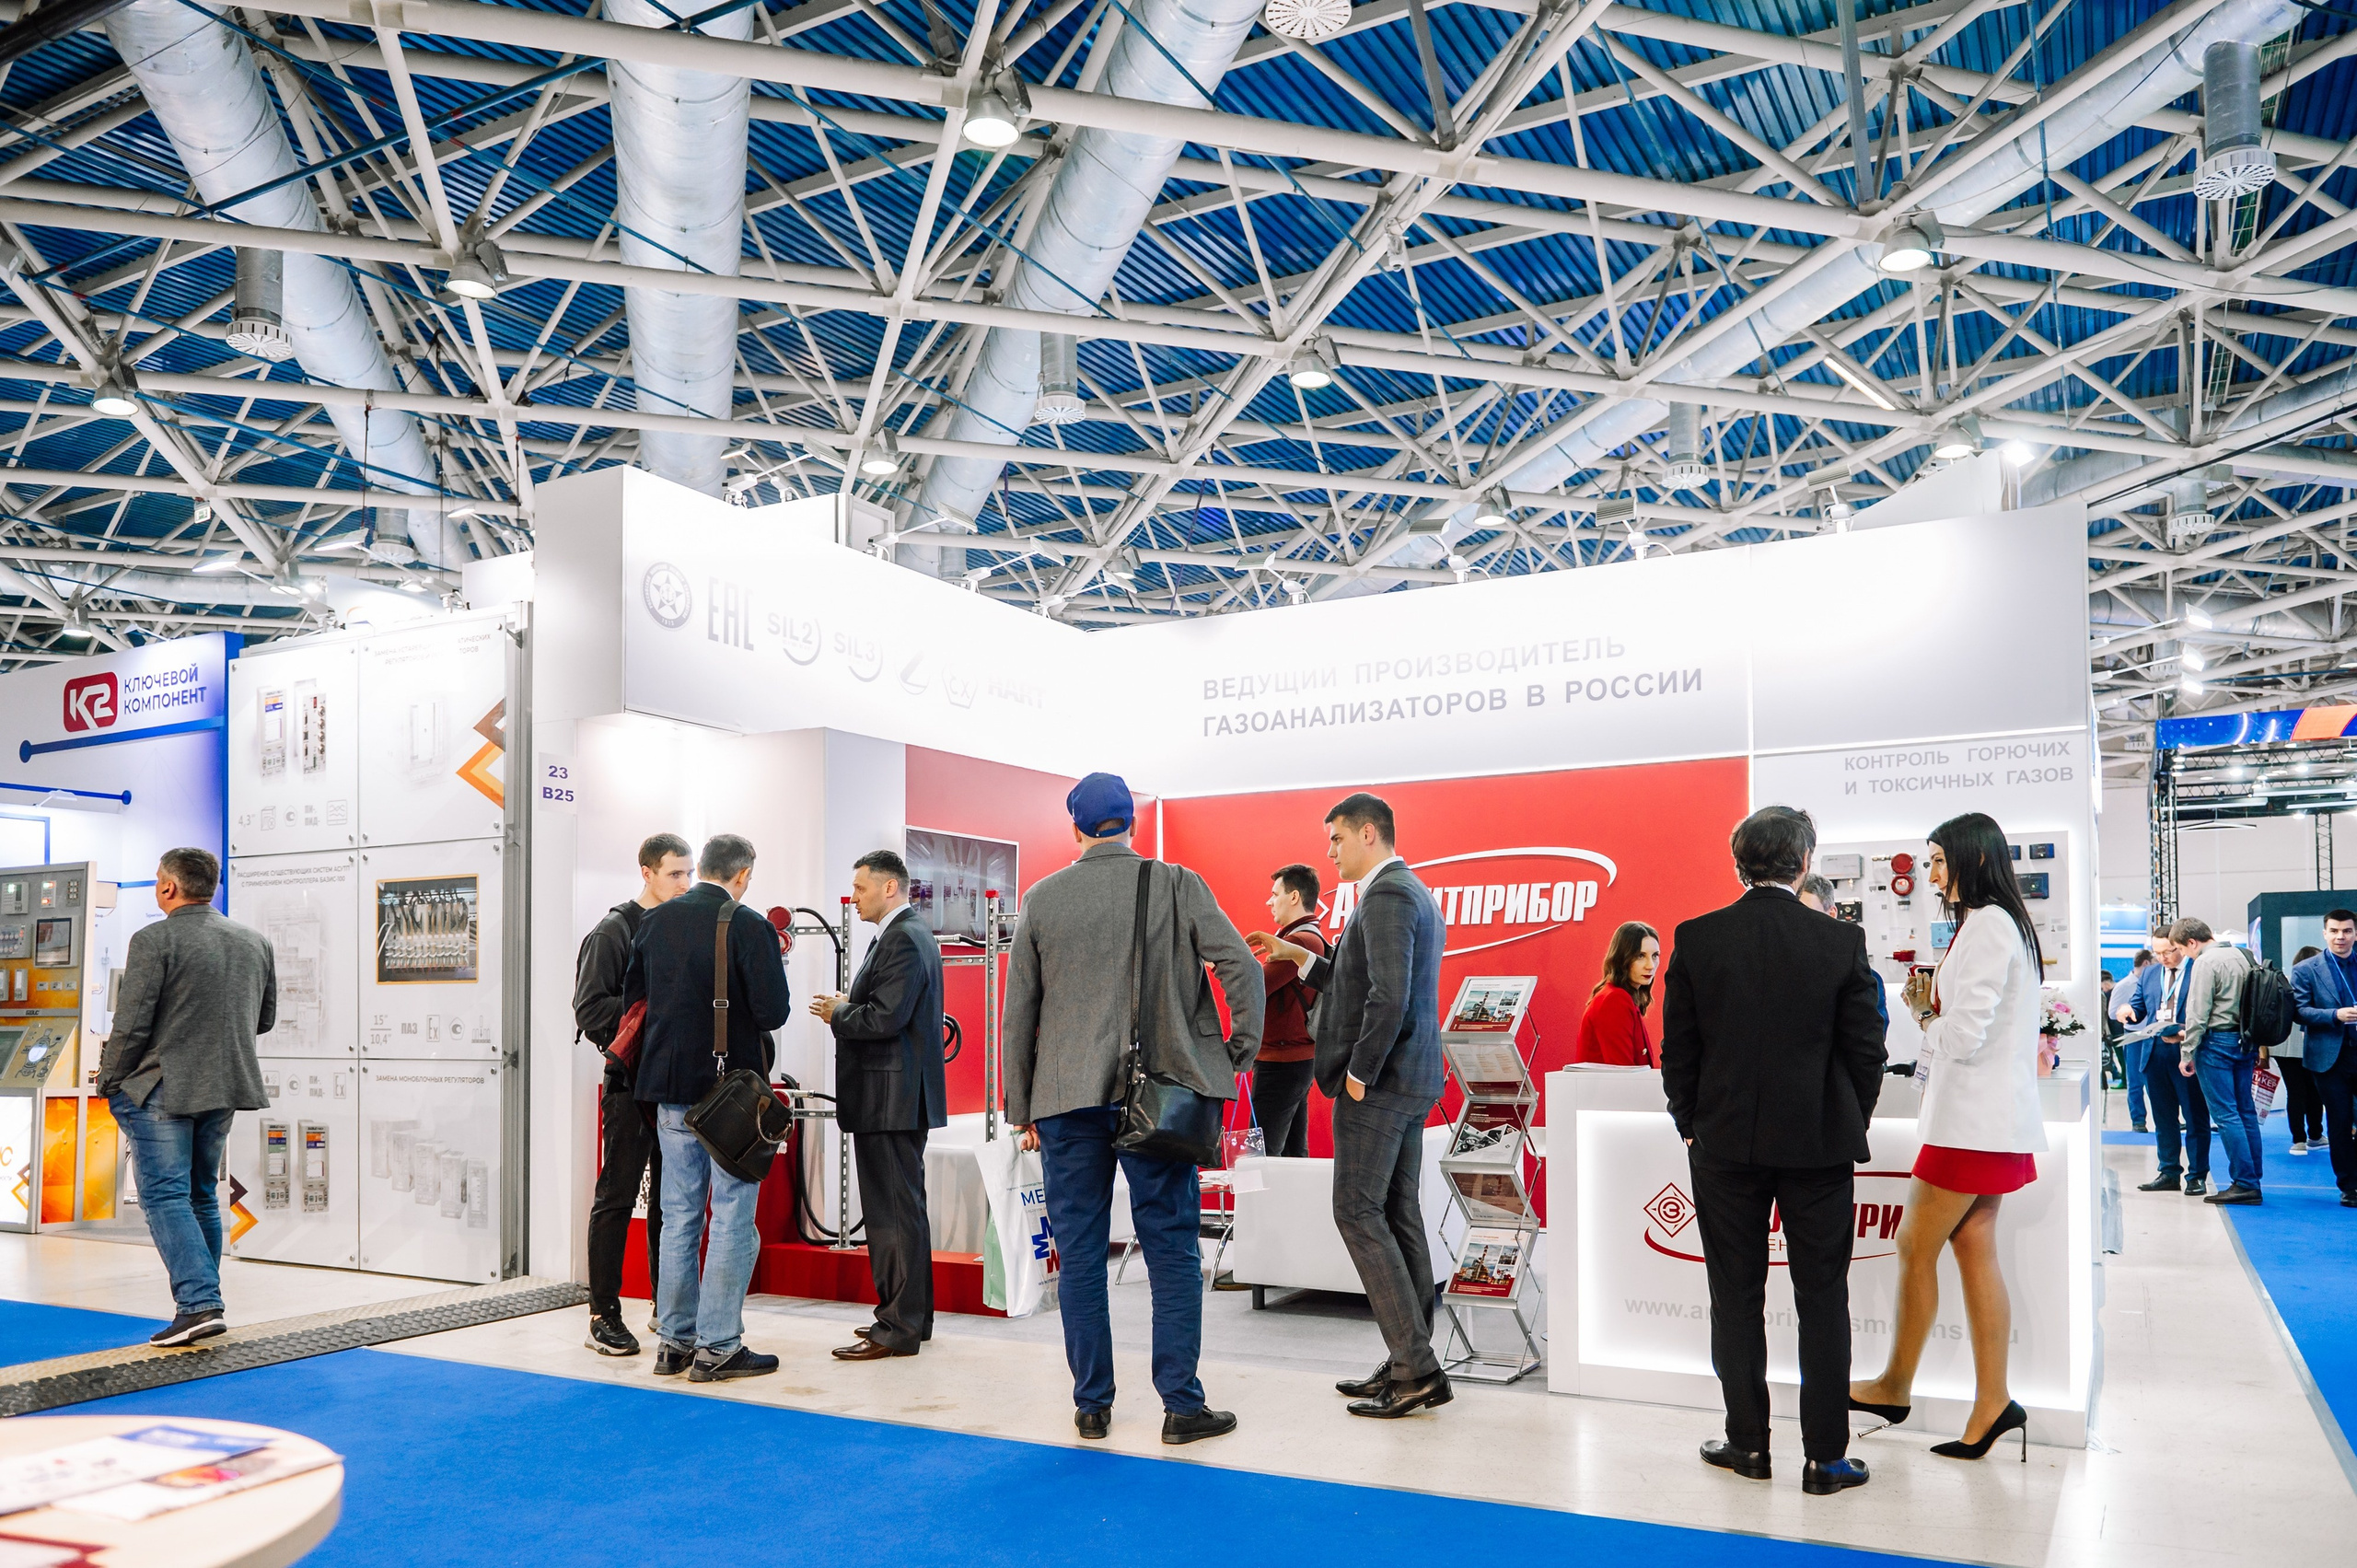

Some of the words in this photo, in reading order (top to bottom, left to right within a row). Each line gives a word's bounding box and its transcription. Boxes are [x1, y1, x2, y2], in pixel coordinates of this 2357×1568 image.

[1355, 635, 1626, 684] ПРОИЗВОДИТЕЛЬ
[124, 663, 199, 693] КЛЮЧЕВОЙ
[124, 686, 207, 714] КОМПОНЕНТ
[1203, 688, 1507, 737] ГАЗОАНАЛИЗАТОРОВ
[1527, 684, 1546, 707] В
[1565, 668, 1702, 703] РОССИИ
[1844, 750, 1950, 771] КОНТРОЛЬ
[1968, 741, 2071, 762] ГОРЮЧИХ
[548, 765, 568, 779] 23
[1844, 781, 1857, 795] И
[1868, 772, 1994, 794] ТОКСИЧНЫХ
[2006, 767, 2073, 784] ГАЗОВ
[1329, 880, 1598, 929] АТПРИБОР
[401, 1022, 418, 1035] ПАЗ
[375, 1074, 398, 1083] ЗАМЕНА
[399, 1075, 443, 1084] МОНОБЛОЧНЫХ
[444, 1076, 485, 1085] РЕГУЛЯТОРОВ
